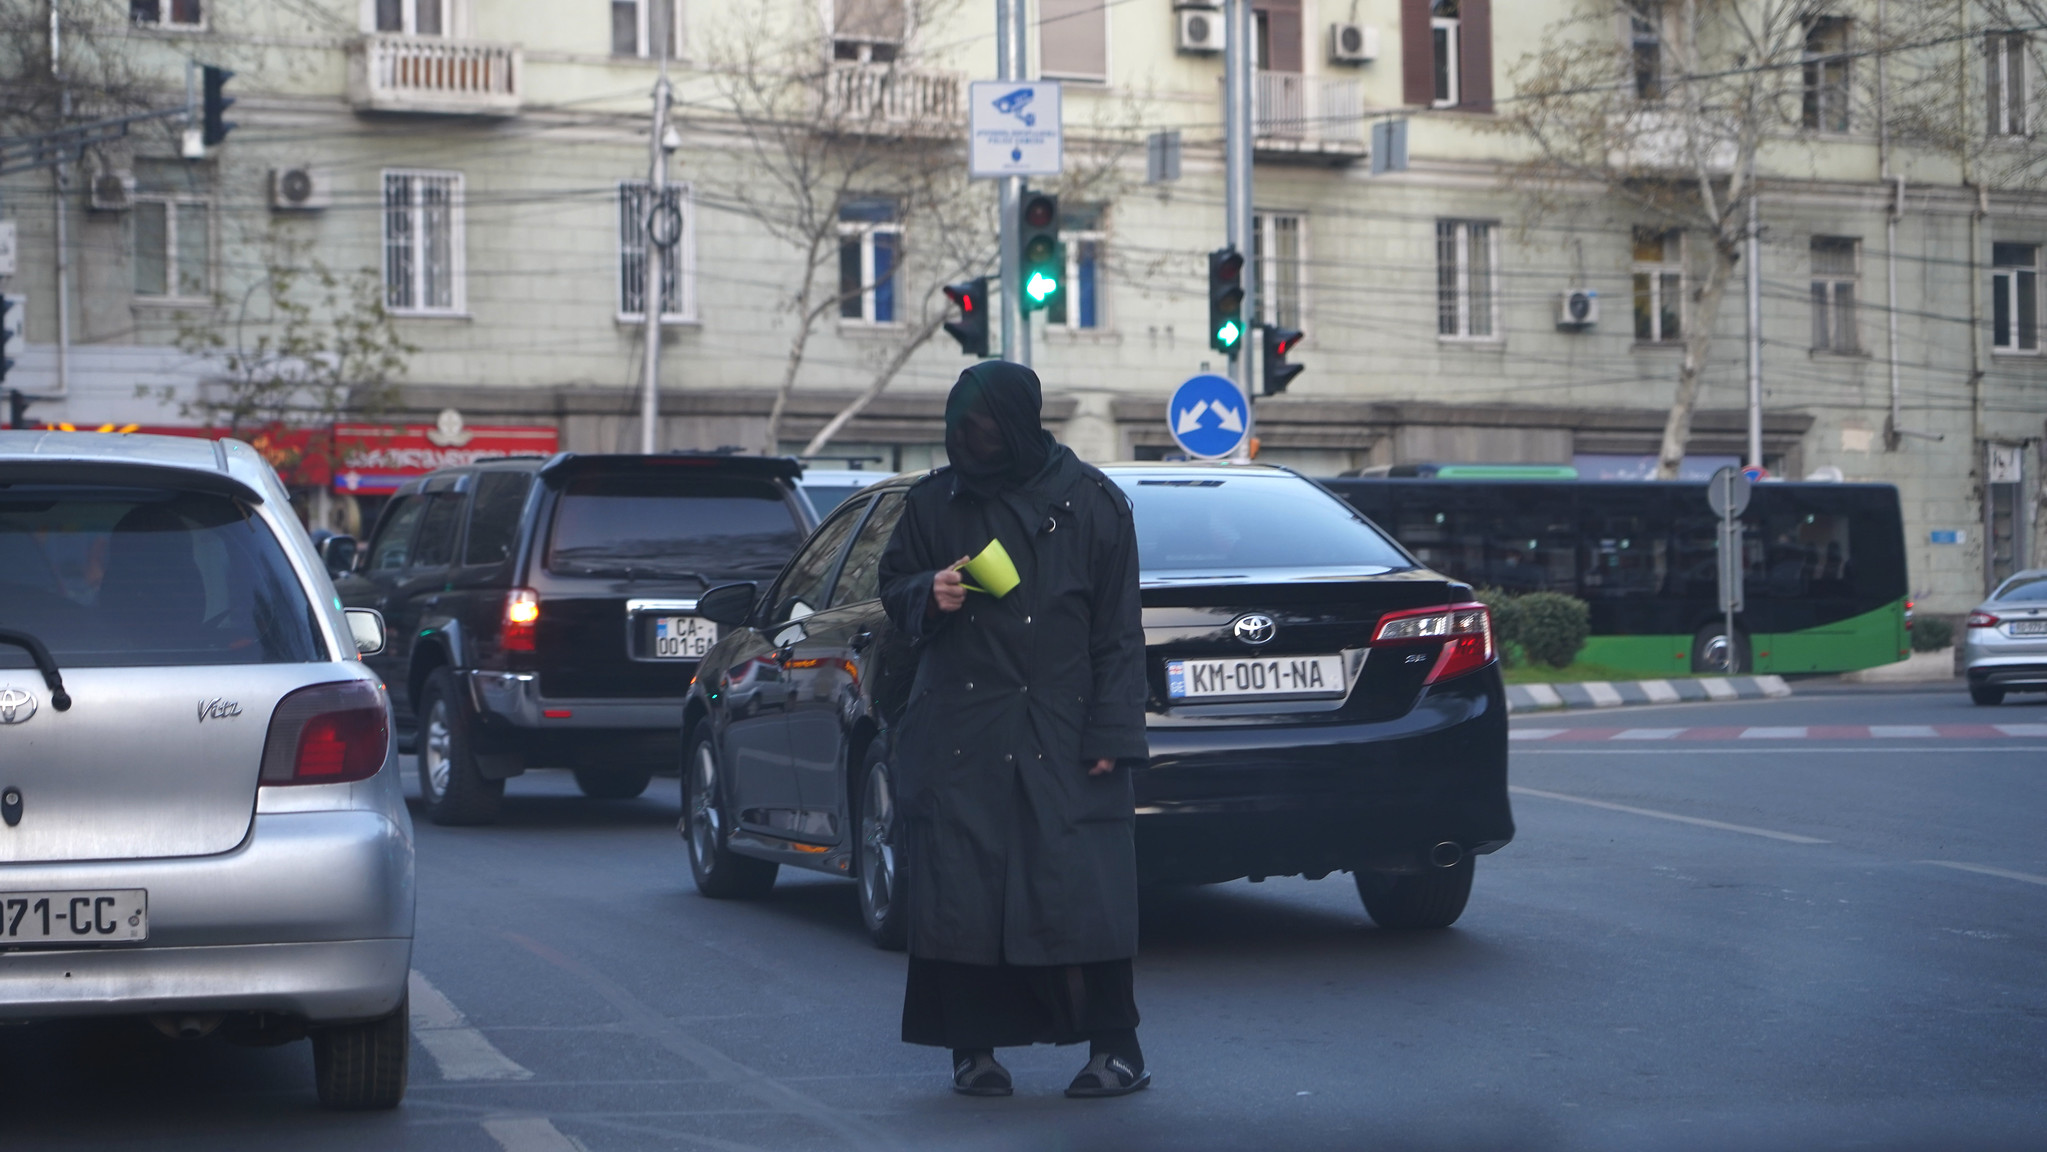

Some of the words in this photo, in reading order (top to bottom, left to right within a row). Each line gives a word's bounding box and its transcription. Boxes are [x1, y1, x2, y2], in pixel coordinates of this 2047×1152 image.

[677, 619, 704, 637] CA-
[1191, 660, 1324, 693] KM-001-NA
[197, 697, 243, 724] Vitz
[0, 897, 117, 936] 71-CC
